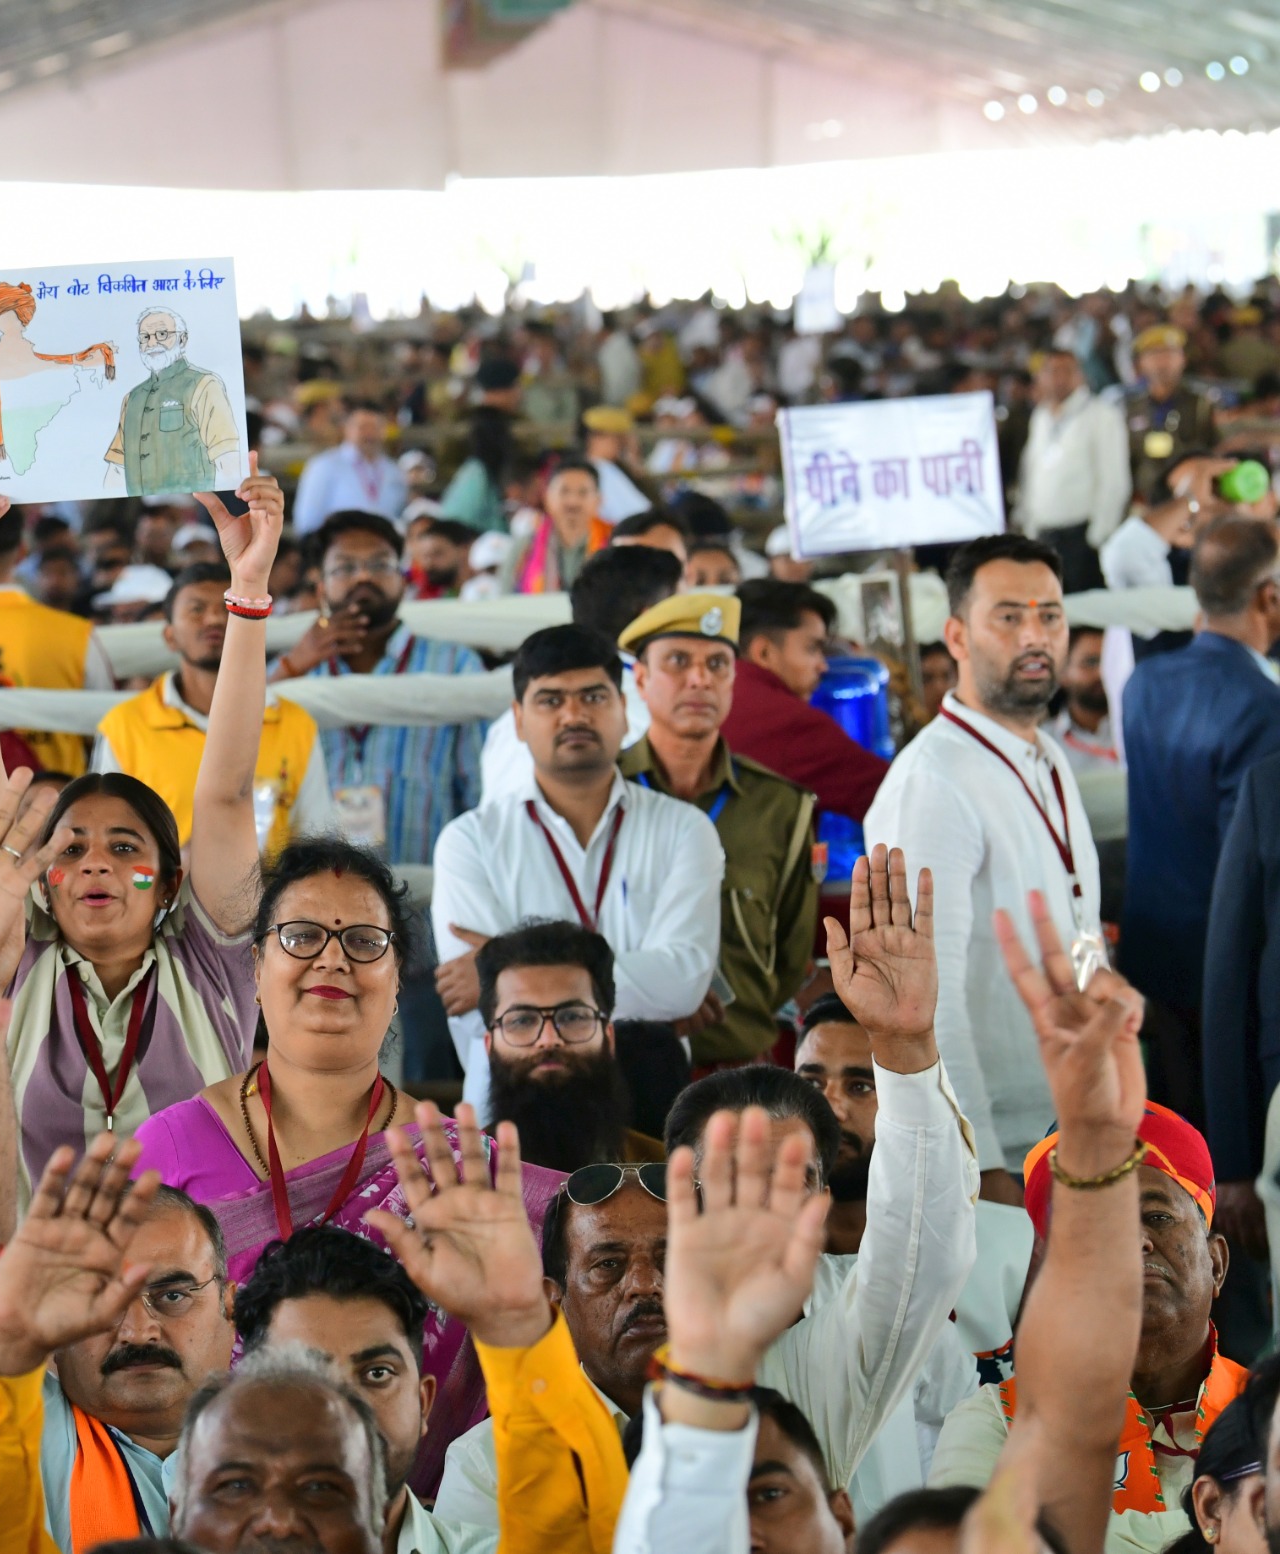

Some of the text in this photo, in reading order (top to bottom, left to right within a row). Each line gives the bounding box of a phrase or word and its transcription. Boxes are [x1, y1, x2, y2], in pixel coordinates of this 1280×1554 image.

[66, 278, 90, 297] वोट
[804, 439, 983, 506] पीने का पानी
